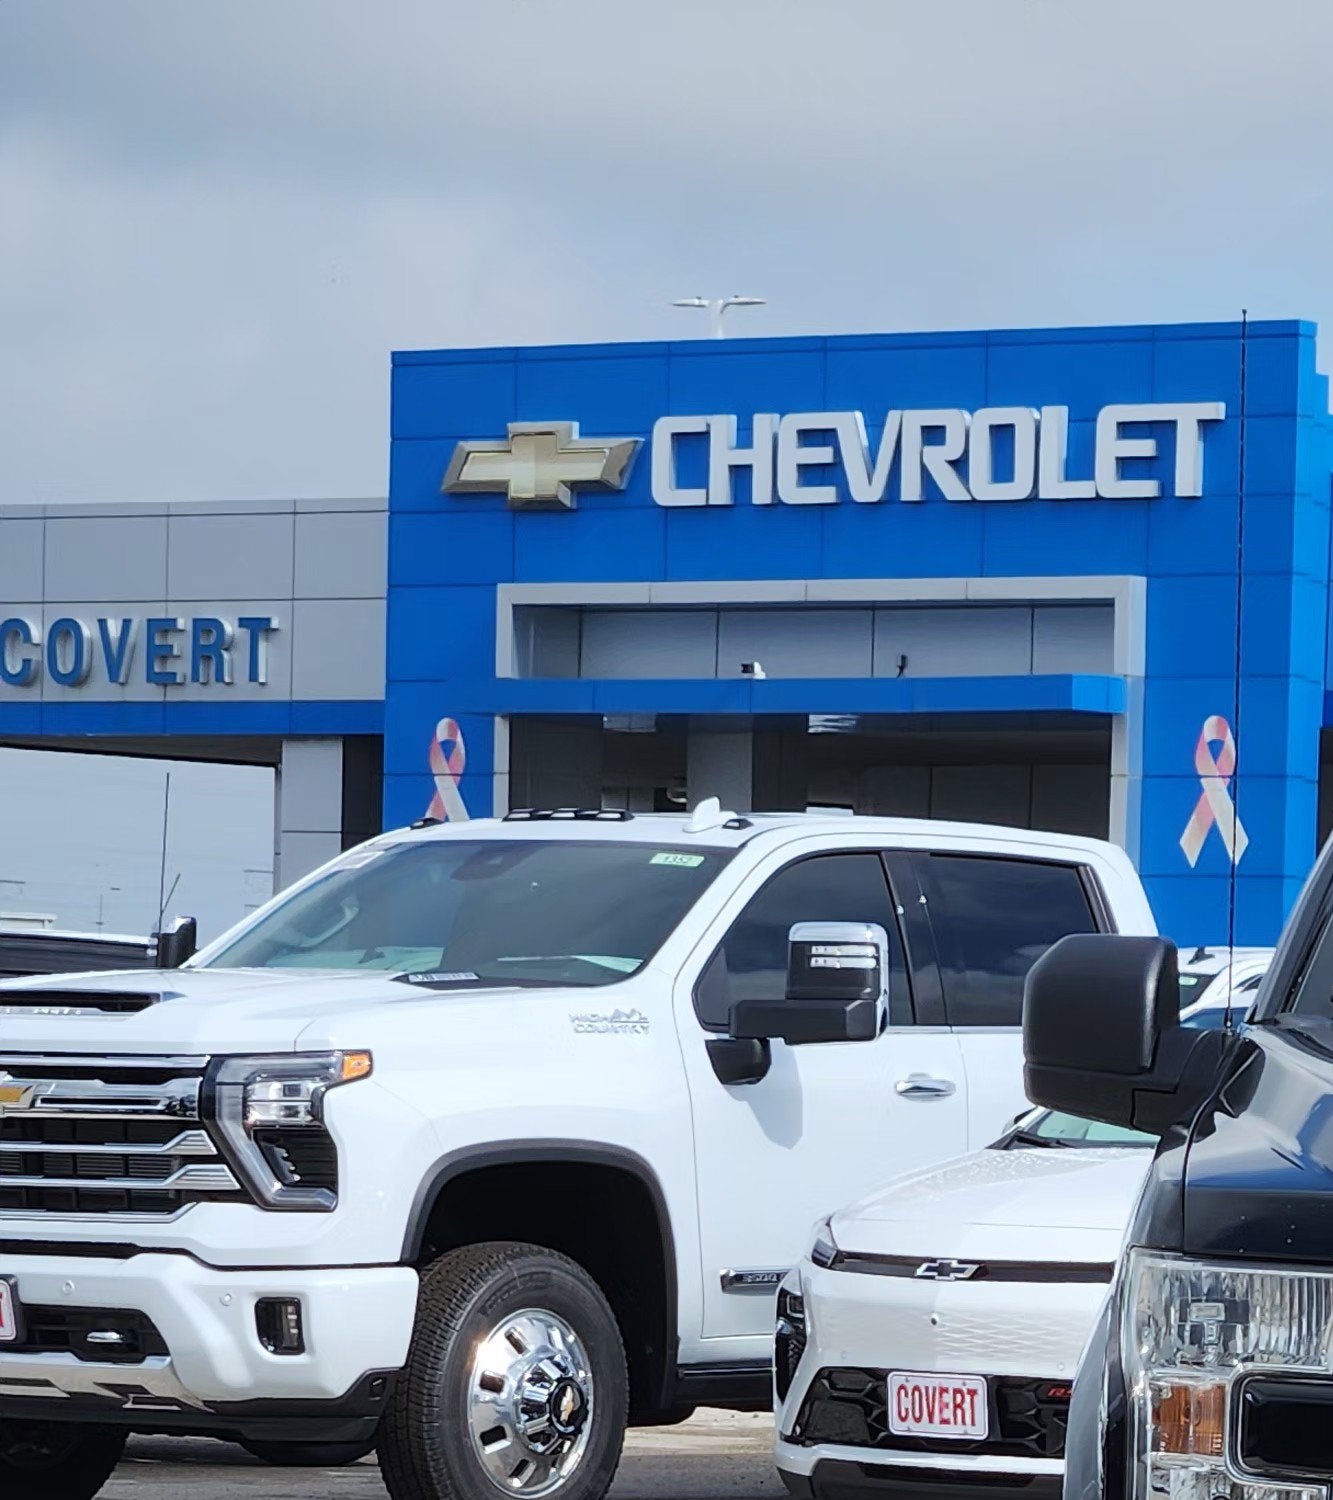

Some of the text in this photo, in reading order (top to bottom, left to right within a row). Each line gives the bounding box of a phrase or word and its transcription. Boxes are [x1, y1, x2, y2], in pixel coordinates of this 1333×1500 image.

[652, 402, 1225, 506] CHEVROLET
[0, 617, 279, 685] COVERT
[897, 1383, 978, 1427] COVERT
